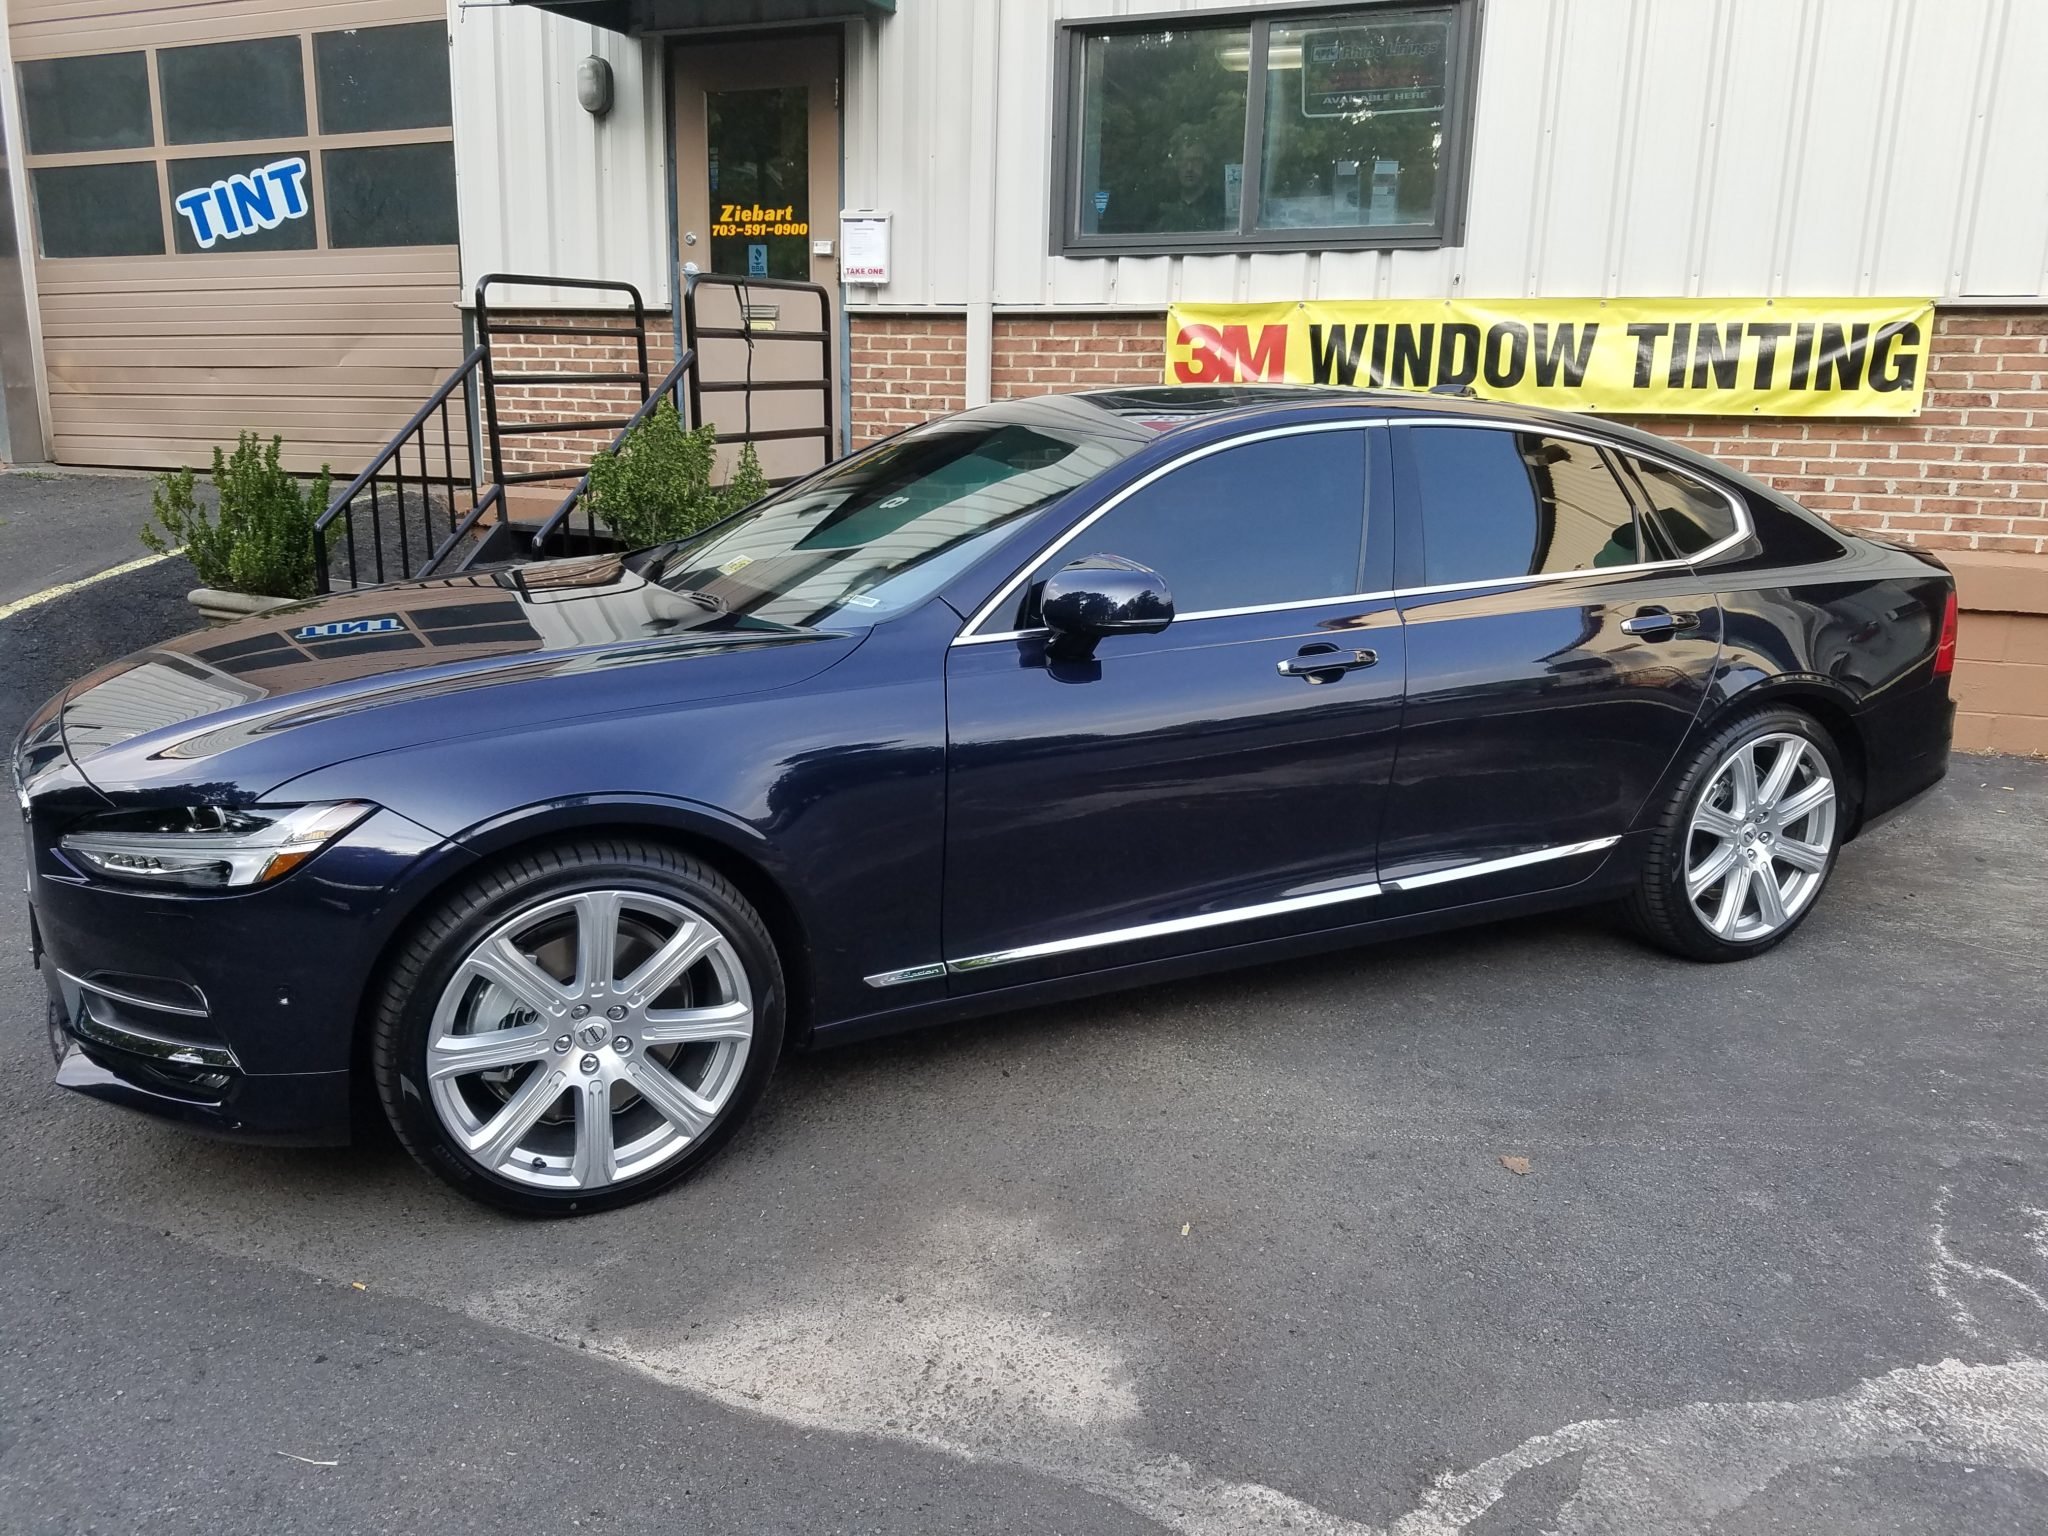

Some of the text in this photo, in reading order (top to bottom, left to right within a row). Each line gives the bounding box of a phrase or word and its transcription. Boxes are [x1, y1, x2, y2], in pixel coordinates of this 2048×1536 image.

[1394, 91, 1428, 101] HERE
[178, 163, 302, 242] TINT
[719, 203, 793, 222] Ziebart
[711, 223, 808, 237] 703-591-0900
[846, 267, 866, 275] TAKE
[1173, 320, 1921, 393] 3M WINDOW TINTING
